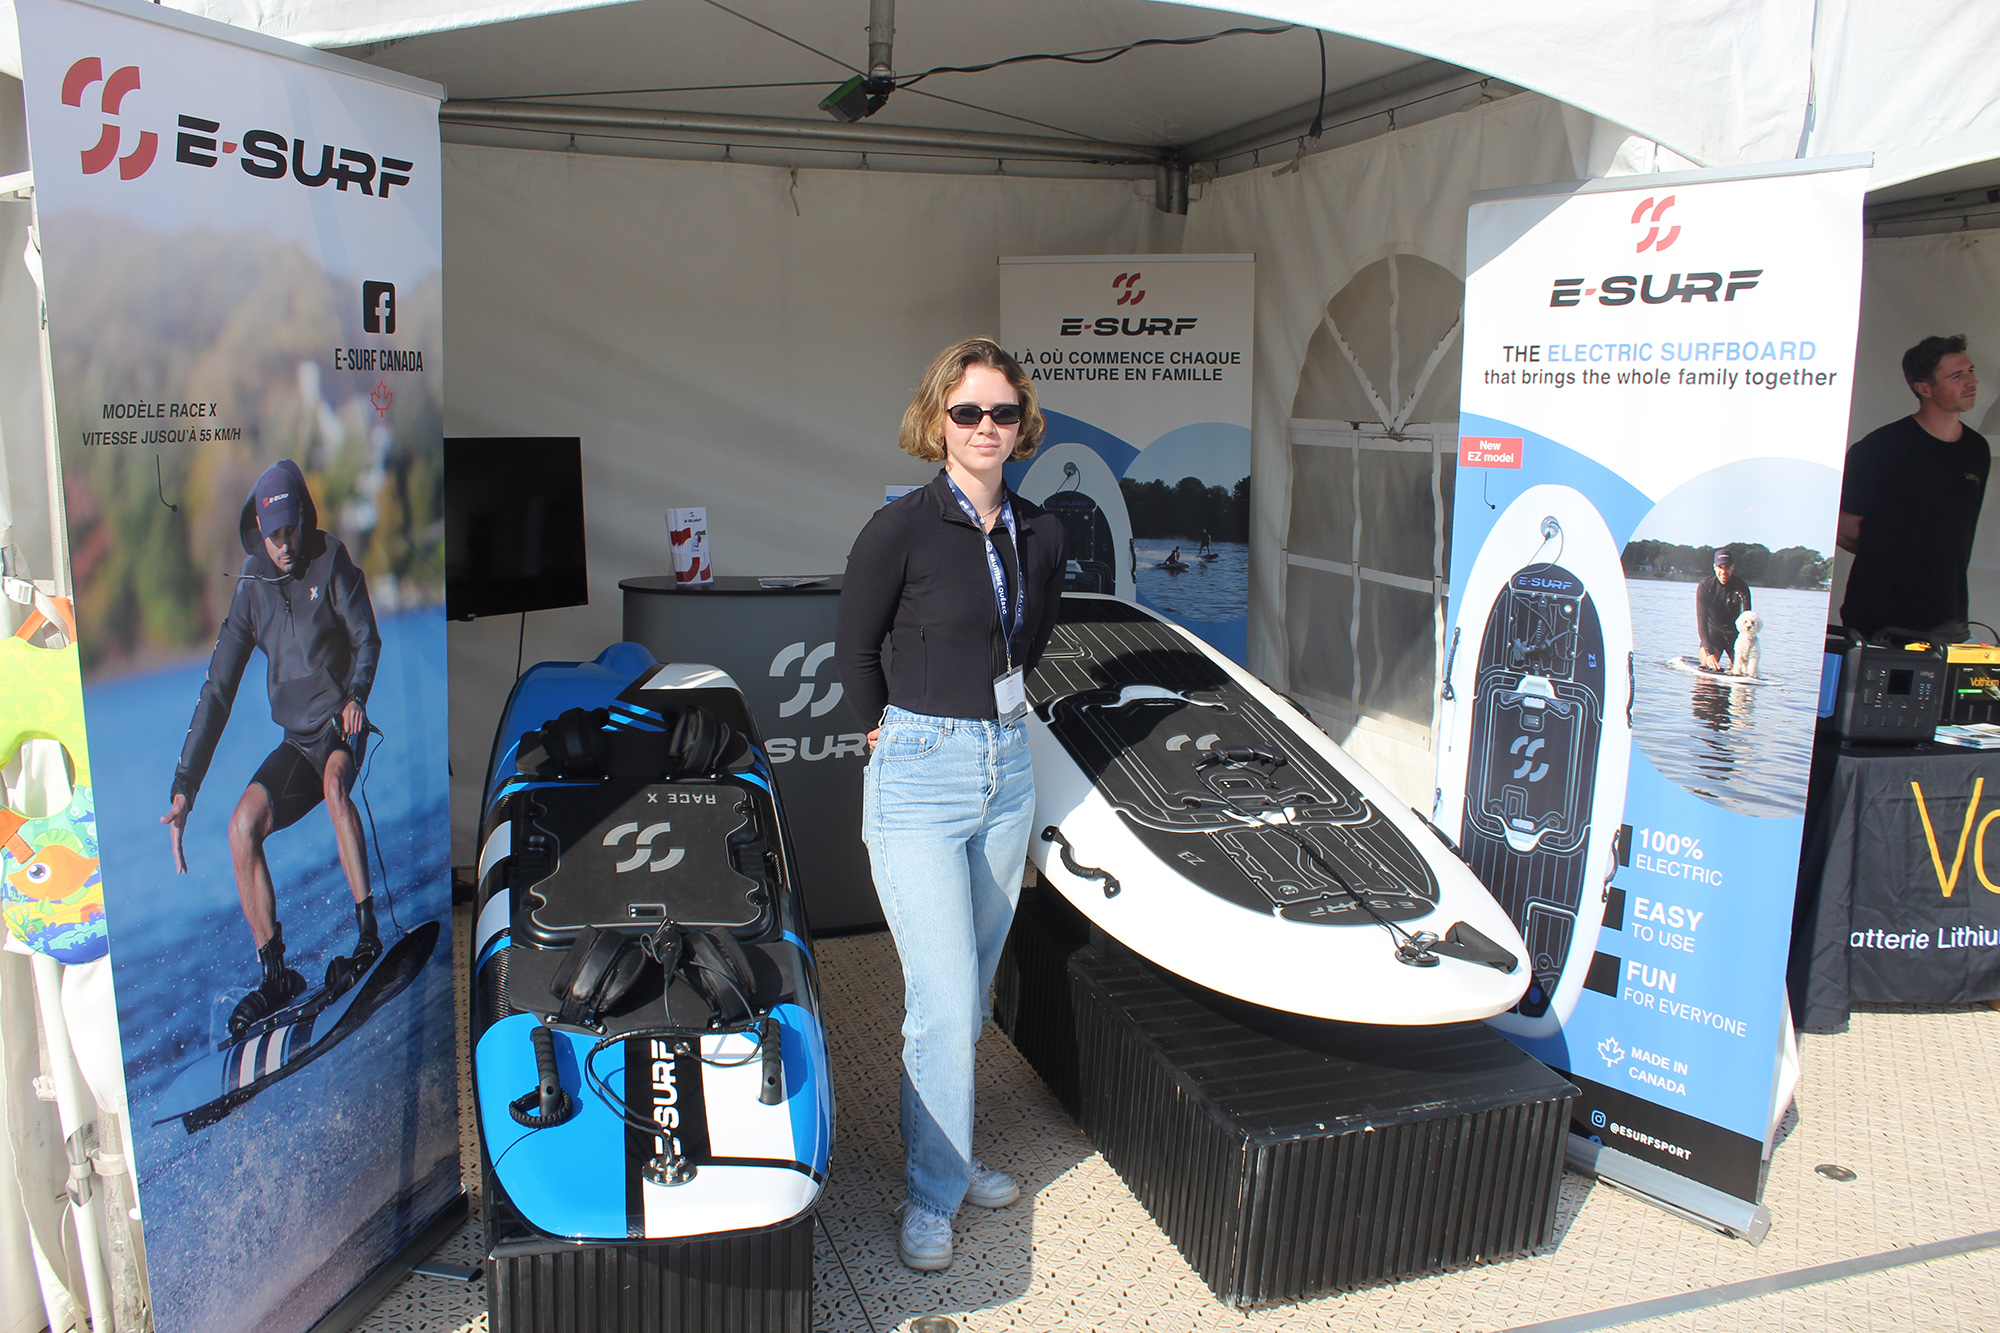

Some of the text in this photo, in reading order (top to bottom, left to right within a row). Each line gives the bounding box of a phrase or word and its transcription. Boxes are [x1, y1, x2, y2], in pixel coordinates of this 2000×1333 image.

[175, 114, 414, 199] E-SURF
[1549, 269, 1764, 307] E-SURF
[1060, 317, 1198, 336] E-SURF
[335, 348, 424, 372] E-SURF CANADA
[1014, 348, 1241, 365] LÀ OÙ COMMENCE CHAQUE
[1503, 341, 1816, 362] THE ELECTRIC SURFBOARD
[1031, 368, 1223, 381] AVENTURE EN FAMILLE
[1484, 368, 1837, 390] that brings the whole family together
[102, 400, 217, 419] MODÈLE RACE X
[82, 426, 241, 446] VITESSE JUSQU'À 55 KM/H
[1479, 440, 1501, 450] New
[1467, 451, 1514, 463] EZ model
[988, 553, 1004, 586] NAUTISME
[1518, 576, 1573, 590] E-SURF
[1587, 653, 1597, 668] EZ
[764, 732, 870, 764] SUR
[647, 793, 717, 805] RACE X
[1640, 828, 1704, 860] 100%
[1177, 850, 1206, 867] EZ
[1636, 853, 1723, 887] ELECTRIC
[1633, 896, 1704, 932] EASY
[1631, 922, 1696, 953] TO USE
[1937, 924, 2000, 949] Lithiu
[1626, 960, 1677, 994] FUN
[1624, 987, 1748, 1038] FOR EVERYONE
[1631, 1046, 1688, 1076] MADE IN
[1628, 1066, 1687, 1096] CANADA
[1609, 1122, 1693, 1160] @ESURFSPORT
